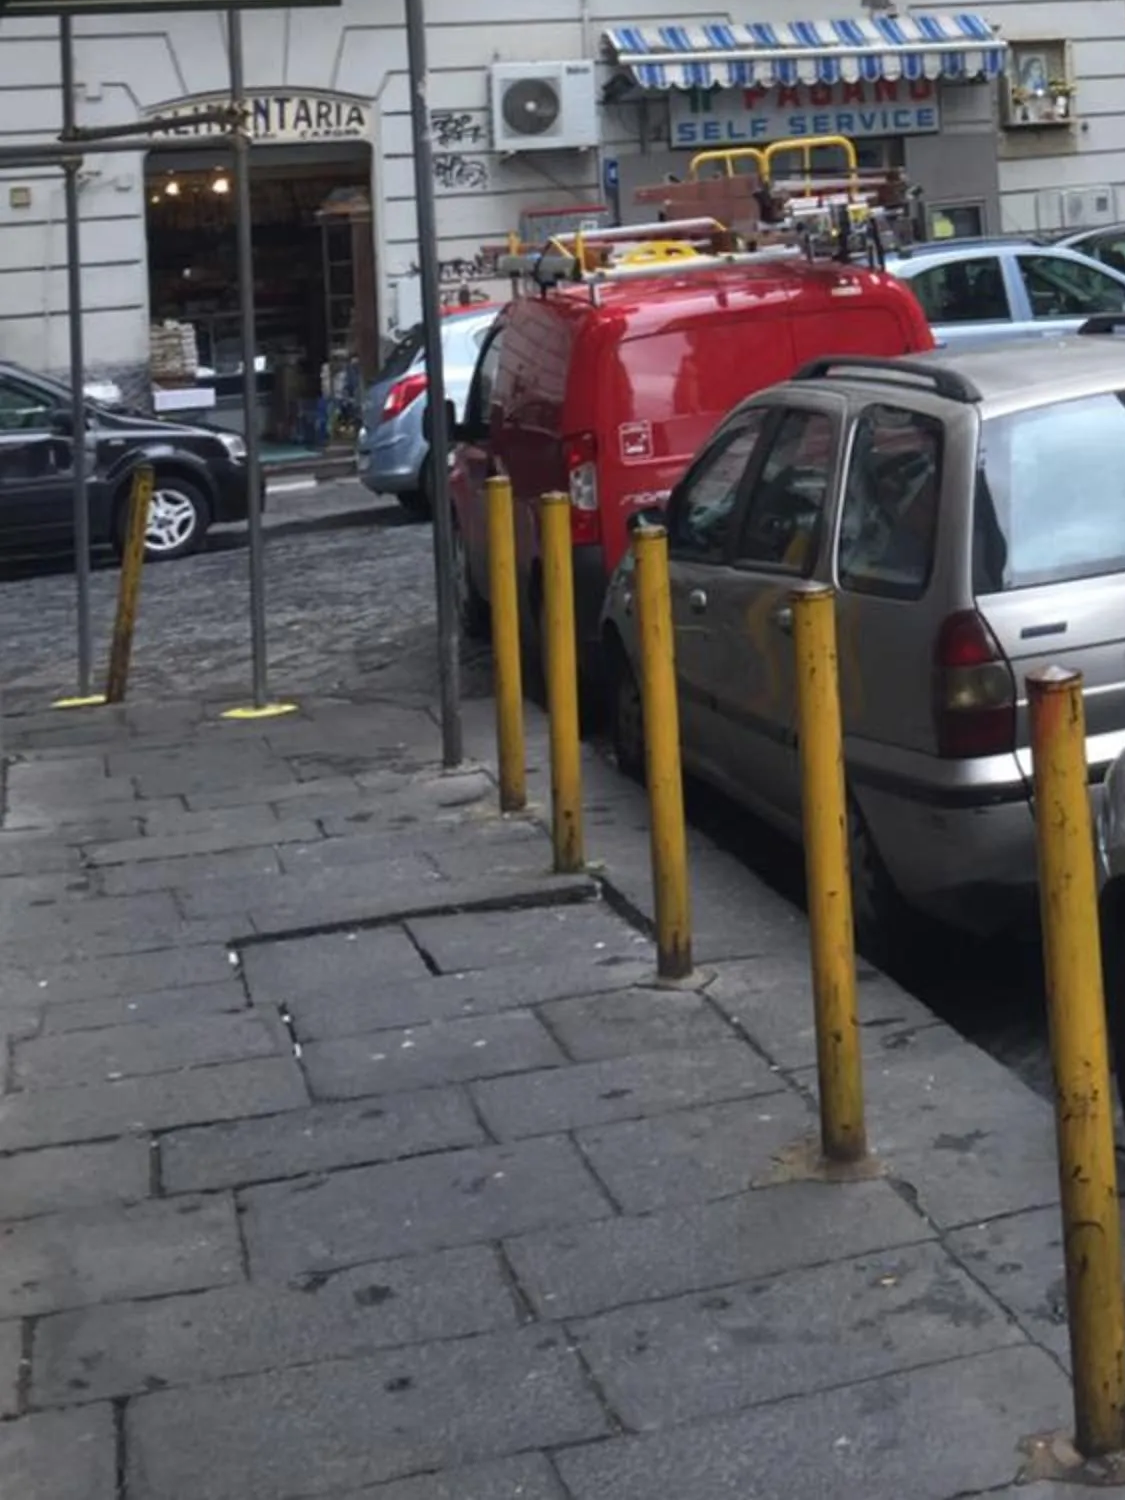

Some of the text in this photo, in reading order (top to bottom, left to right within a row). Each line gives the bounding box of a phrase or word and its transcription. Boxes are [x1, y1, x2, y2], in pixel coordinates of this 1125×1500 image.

[148, 97, 366, 136] ALIMNTARIA
[677, 108, 935, 142] SELF SERVICE
